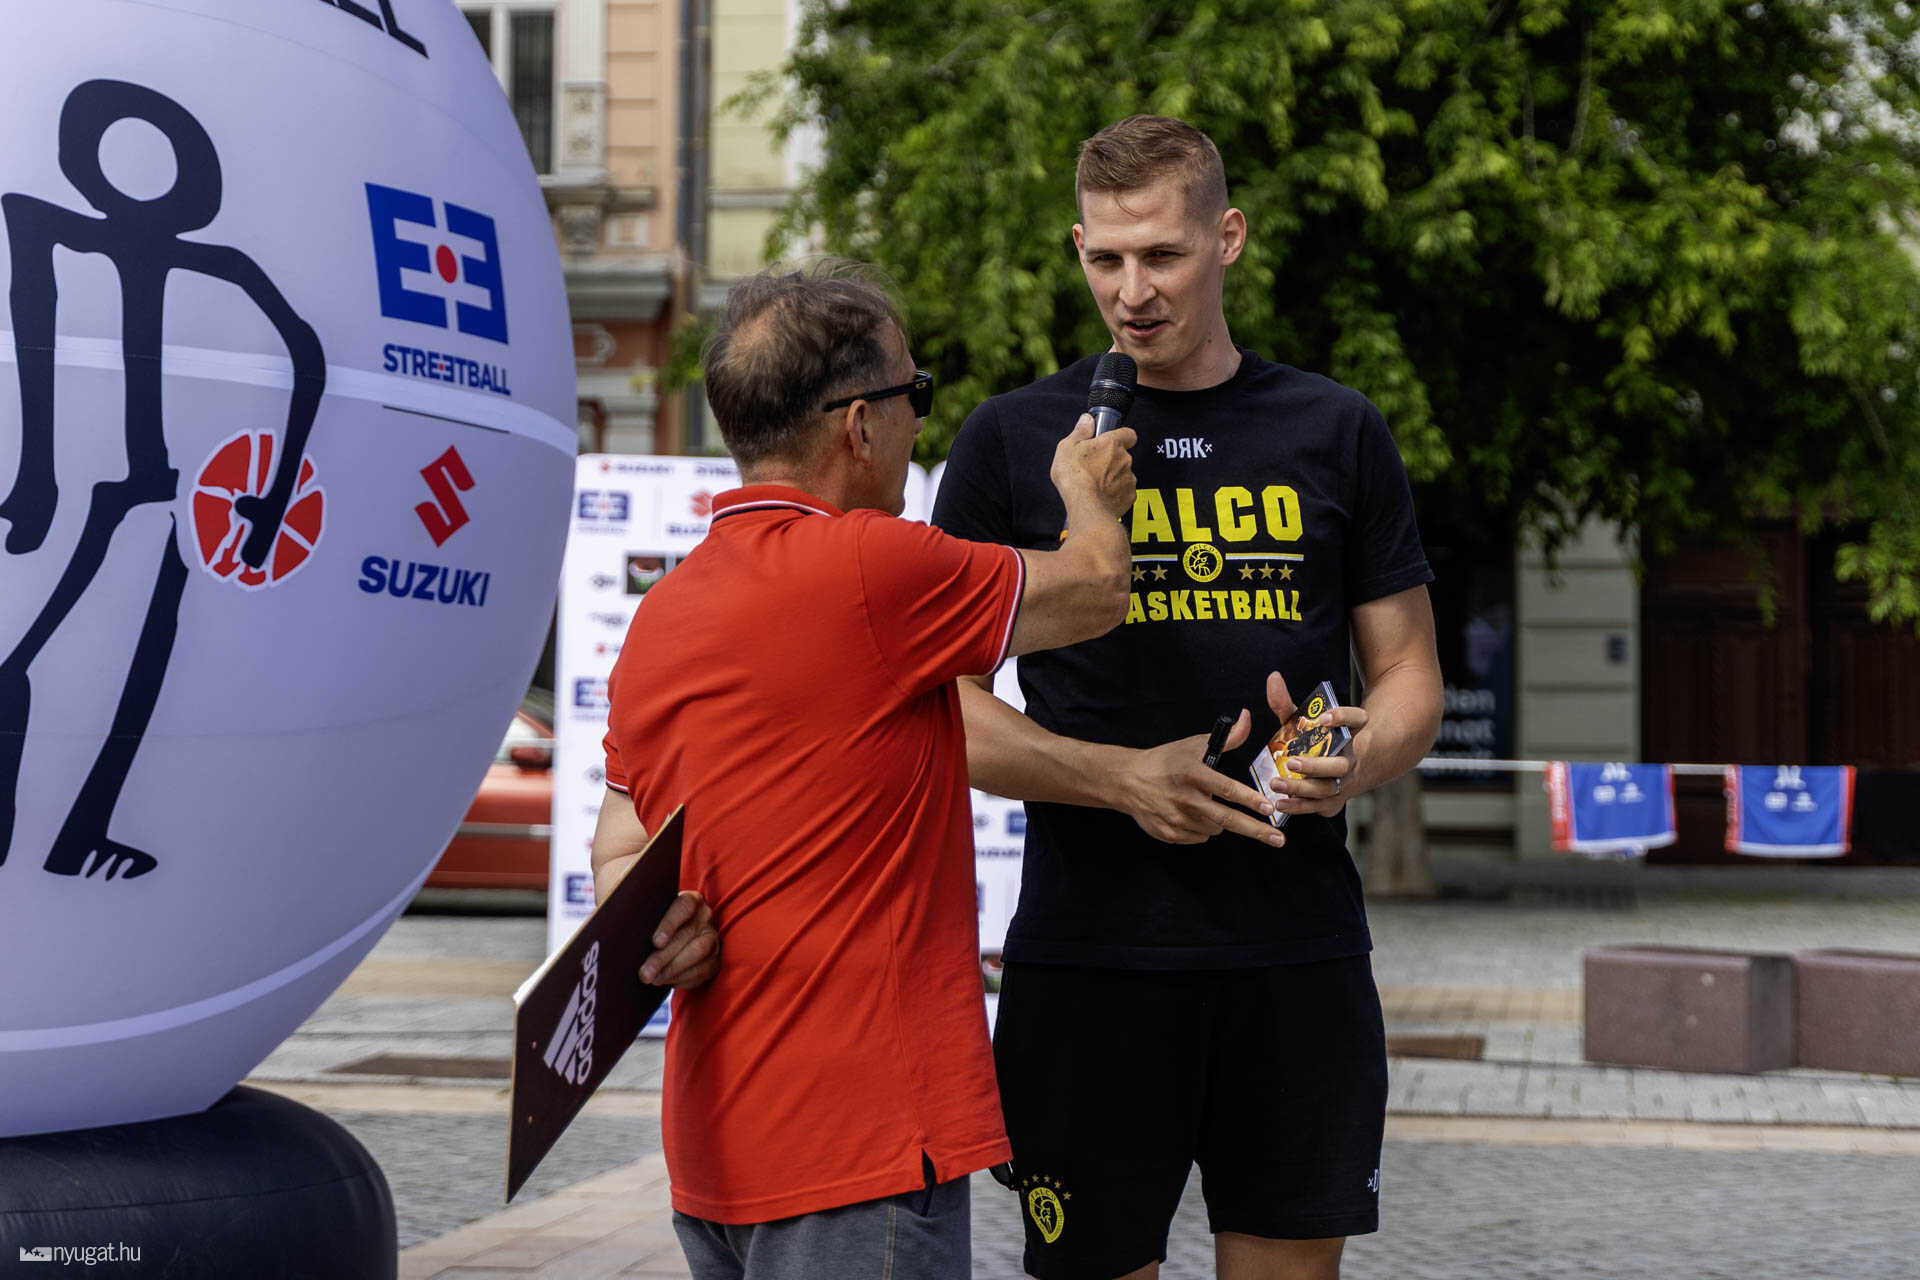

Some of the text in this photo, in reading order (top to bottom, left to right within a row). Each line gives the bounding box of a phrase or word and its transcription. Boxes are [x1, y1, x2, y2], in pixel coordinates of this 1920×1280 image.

[1131, 485, 1303, 543] ALCO
[358, 556, 491, 607] SUZUKI
[1125, 588, 1303, 625] ASKETBALL
[575, 940, 600, 1086] adidas
